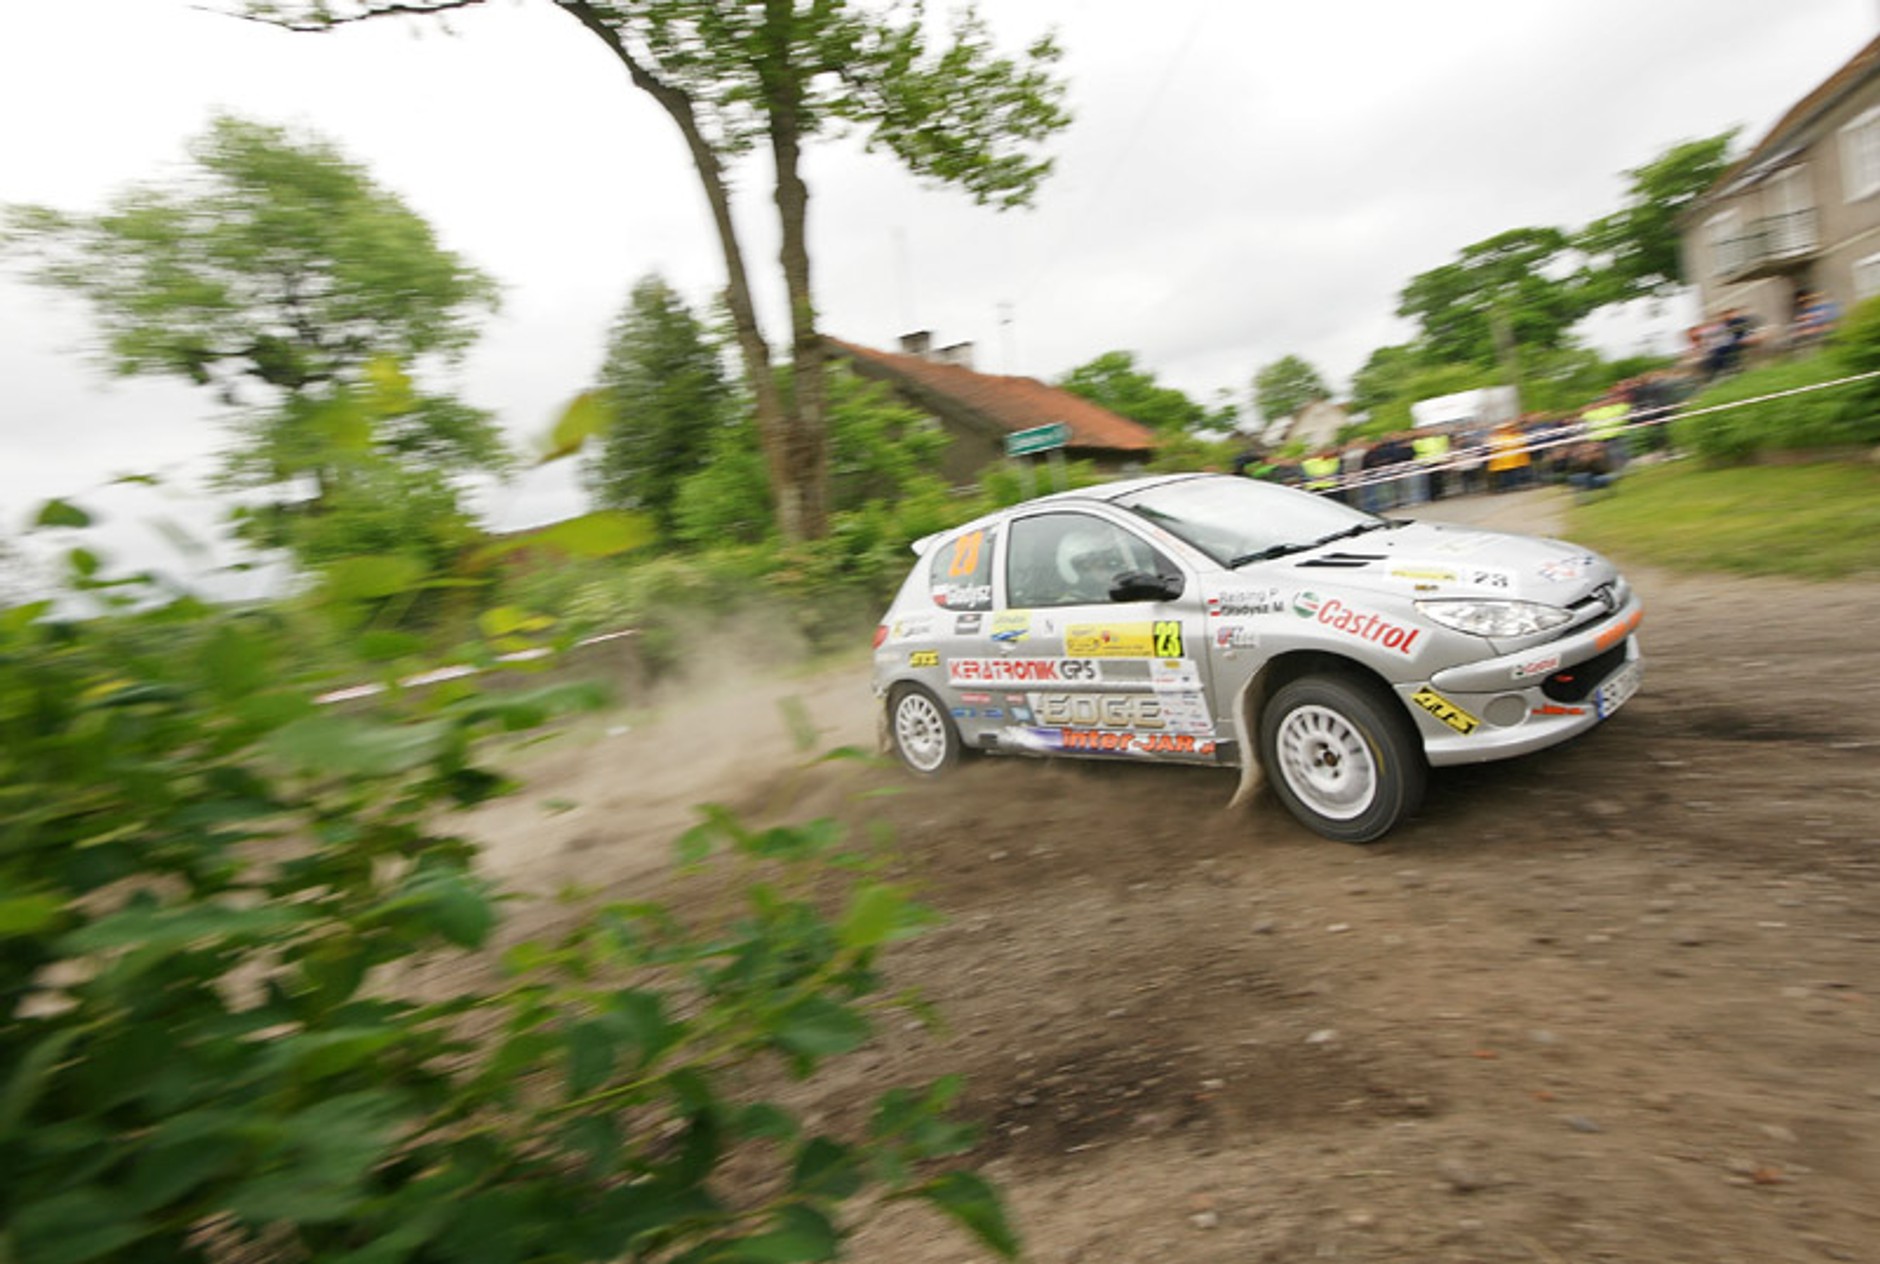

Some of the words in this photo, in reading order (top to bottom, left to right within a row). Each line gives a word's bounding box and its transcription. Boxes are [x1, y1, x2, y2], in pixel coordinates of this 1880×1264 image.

[1473, 571, 1508, 588] 23
[1156, 621, 1181, 656] 23
[1318, 599, 1420, 654] Castrol
[951, 660, 1058, 680] KERATRONIK
[1060, 660, 1096, 680] GPS
[1042, 693, 1166, 728] EDGE
